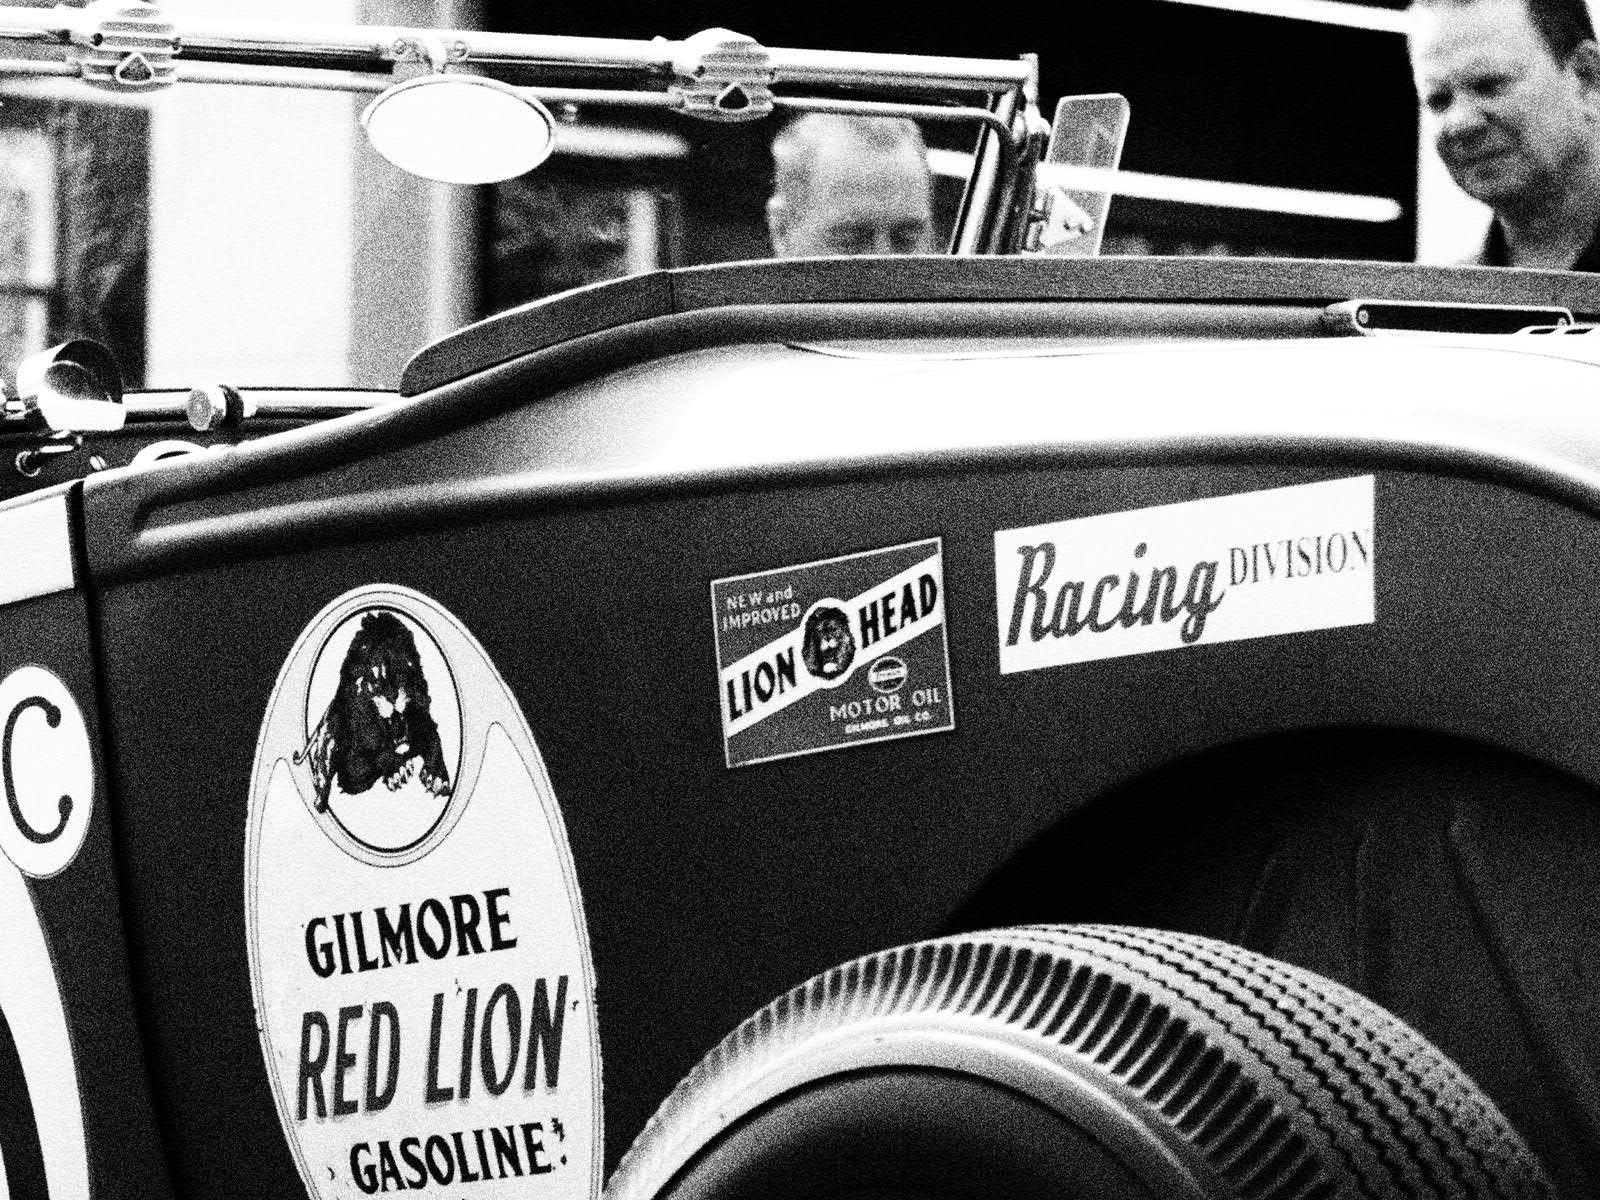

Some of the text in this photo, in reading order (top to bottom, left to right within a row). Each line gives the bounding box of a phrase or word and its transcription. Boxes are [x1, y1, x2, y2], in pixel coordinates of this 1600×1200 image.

[722, 602, 801, 632] IMPROVED
[727, 591, 763, 609] NEW
[1005, 529, 1370, 644] Racing DIVISION
[726, 573, 938, 722] LION HEAD
[829, 687, 942, 722] MOTOR OIL
[2, 696, 73, 844] C
[304, 887, 518, 979] GILMORE
[296, 974, 569, 1124] RED LION
[349, 1121, 553, 1196] GASOLINE
